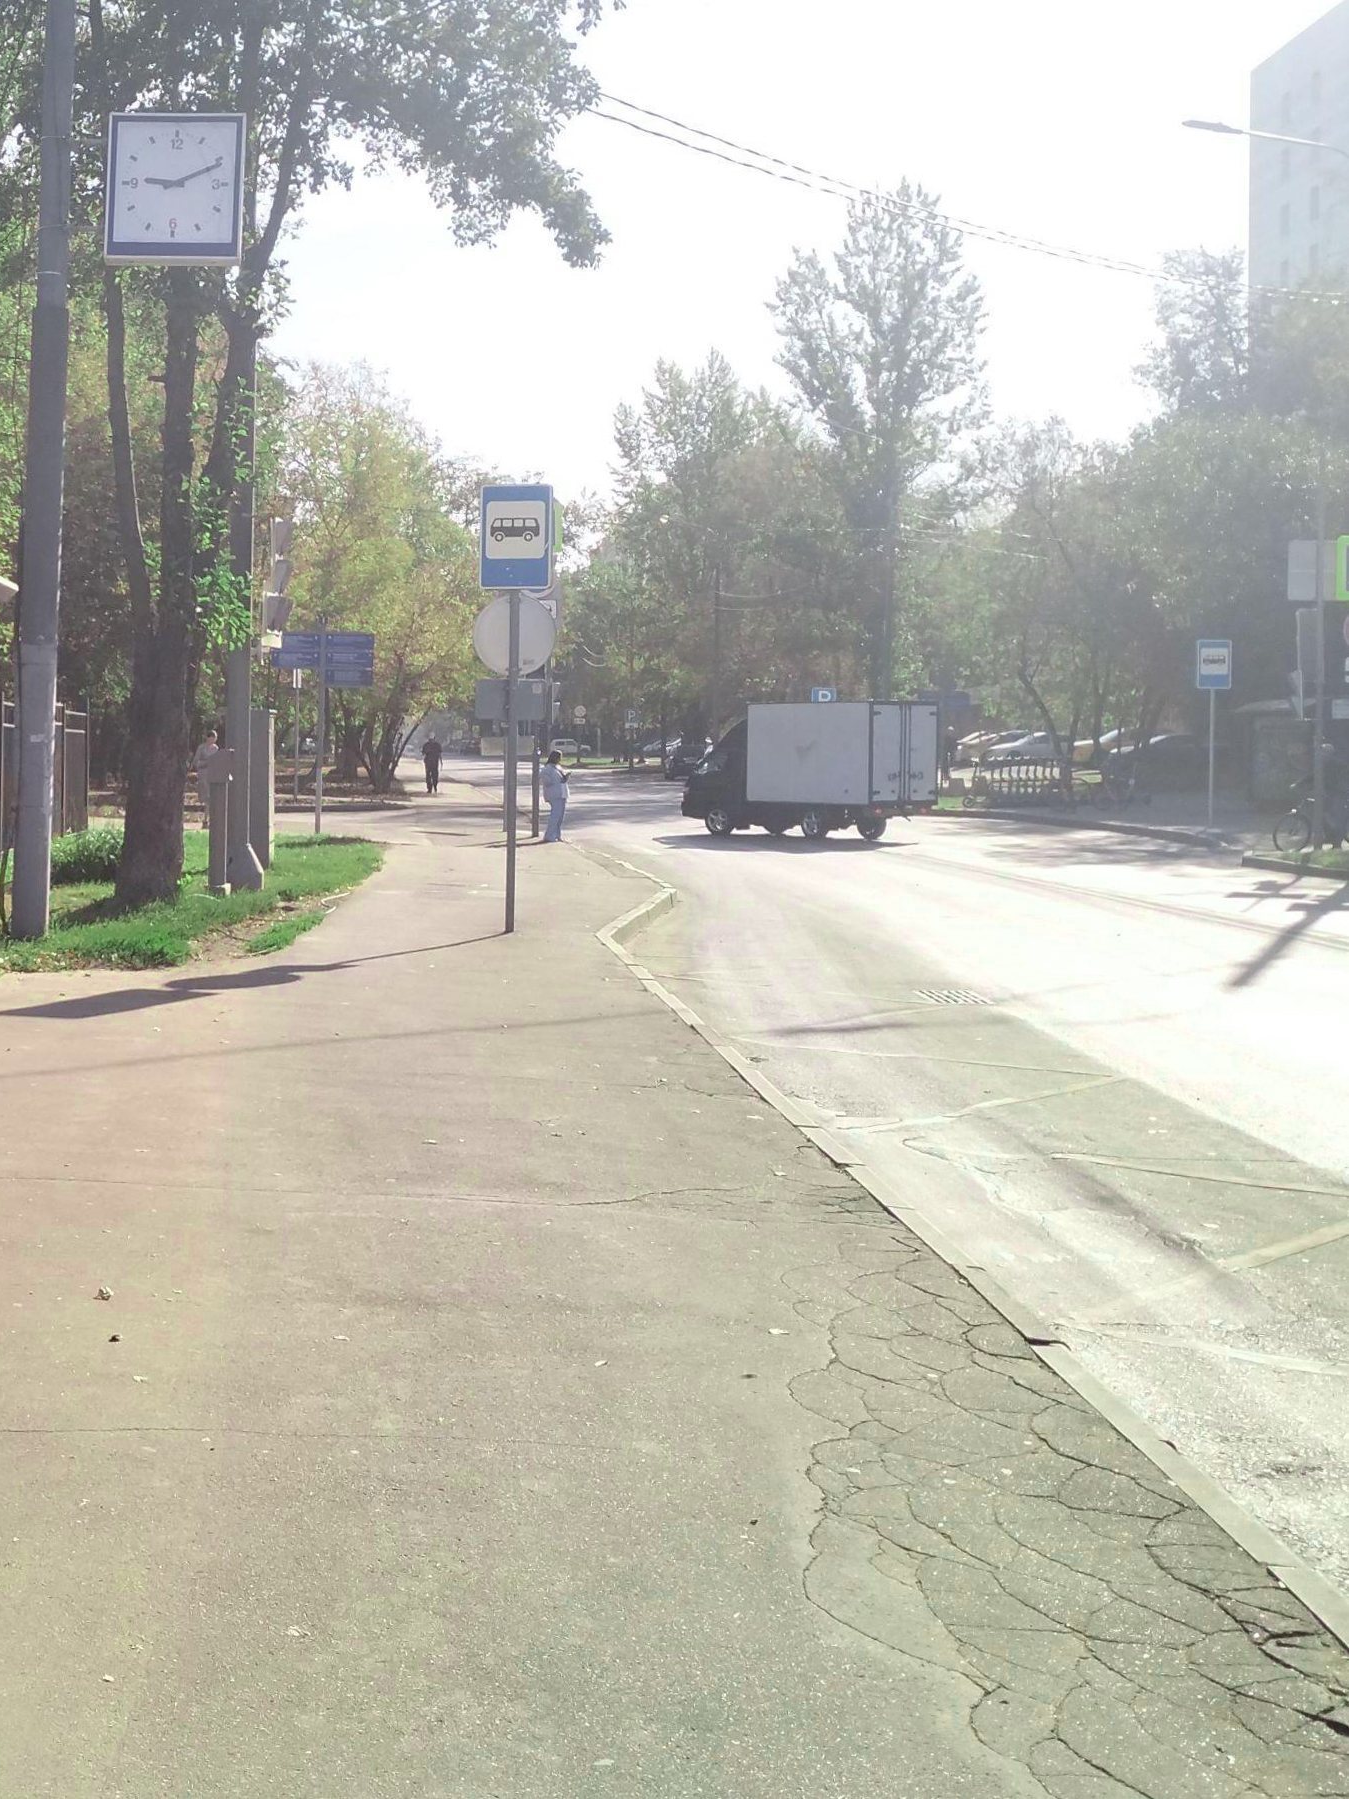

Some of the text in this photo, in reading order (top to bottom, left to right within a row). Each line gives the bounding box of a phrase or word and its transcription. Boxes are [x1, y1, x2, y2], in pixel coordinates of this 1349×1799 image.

[171, 138, 184, 150] 12
[131, 177, 139, 189] 9
[211, 178, 220, 190] 3
[169, 218, 178, 229] 6
